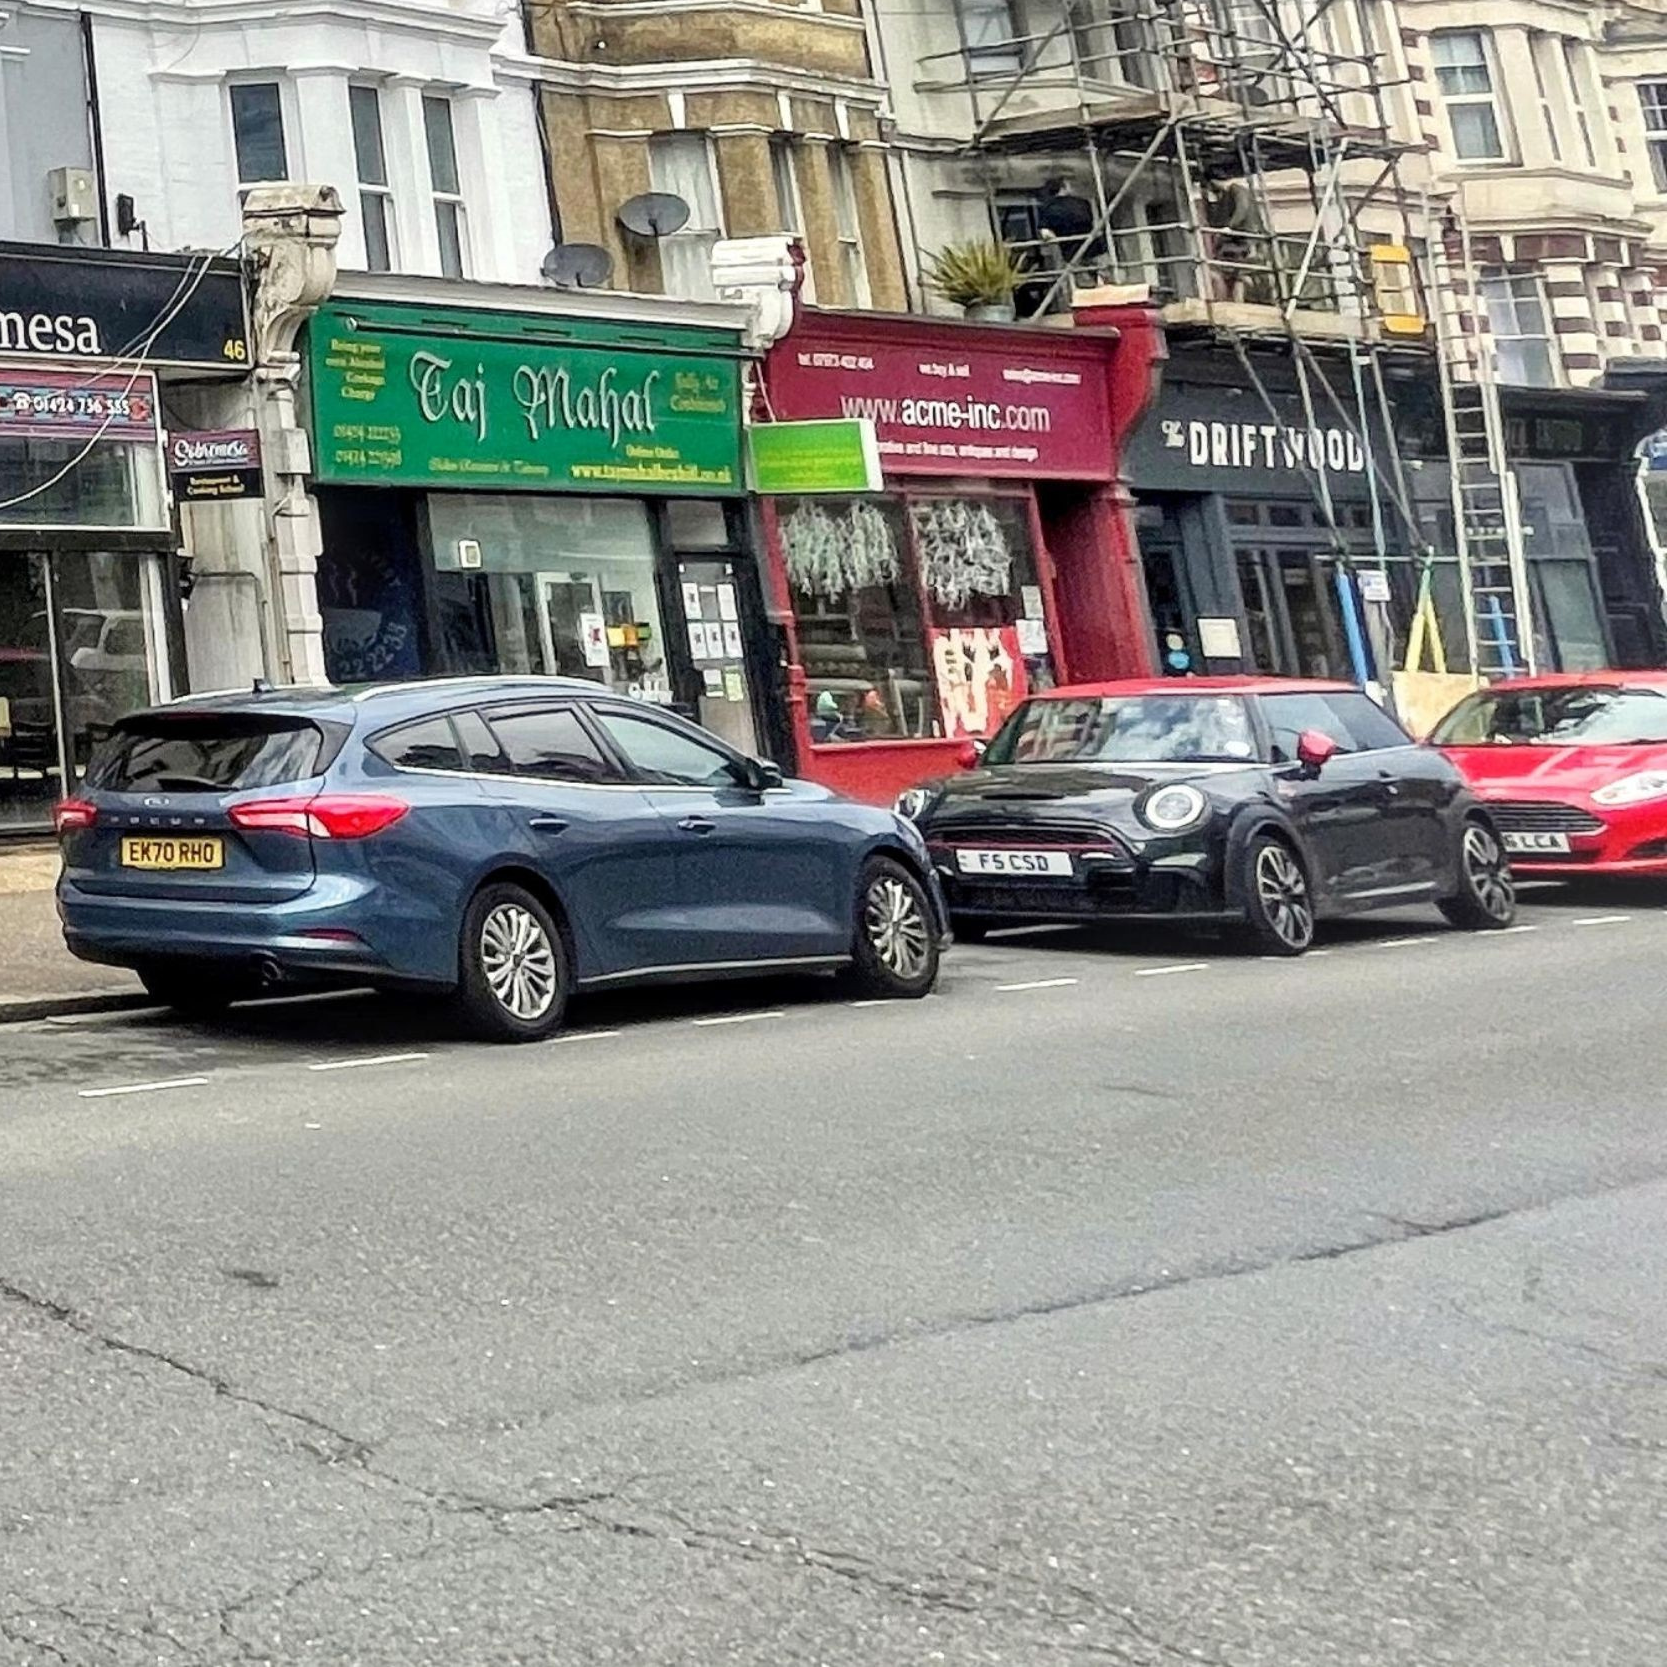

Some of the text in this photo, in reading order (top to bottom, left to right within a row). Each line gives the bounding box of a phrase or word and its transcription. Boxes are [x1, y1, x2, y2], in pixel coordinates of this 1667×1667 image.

[223, 338, 247, 361] 46
[33, 395, 75, 413] 01424
[409, 351, 660, 449] Taj Mahal
[841, 395, 1051, 433] www.acme-inc.com
[1188, 420, 1366, 473] DRIFTWOOD
[129, 841, 215, 863] EK70 RHO
